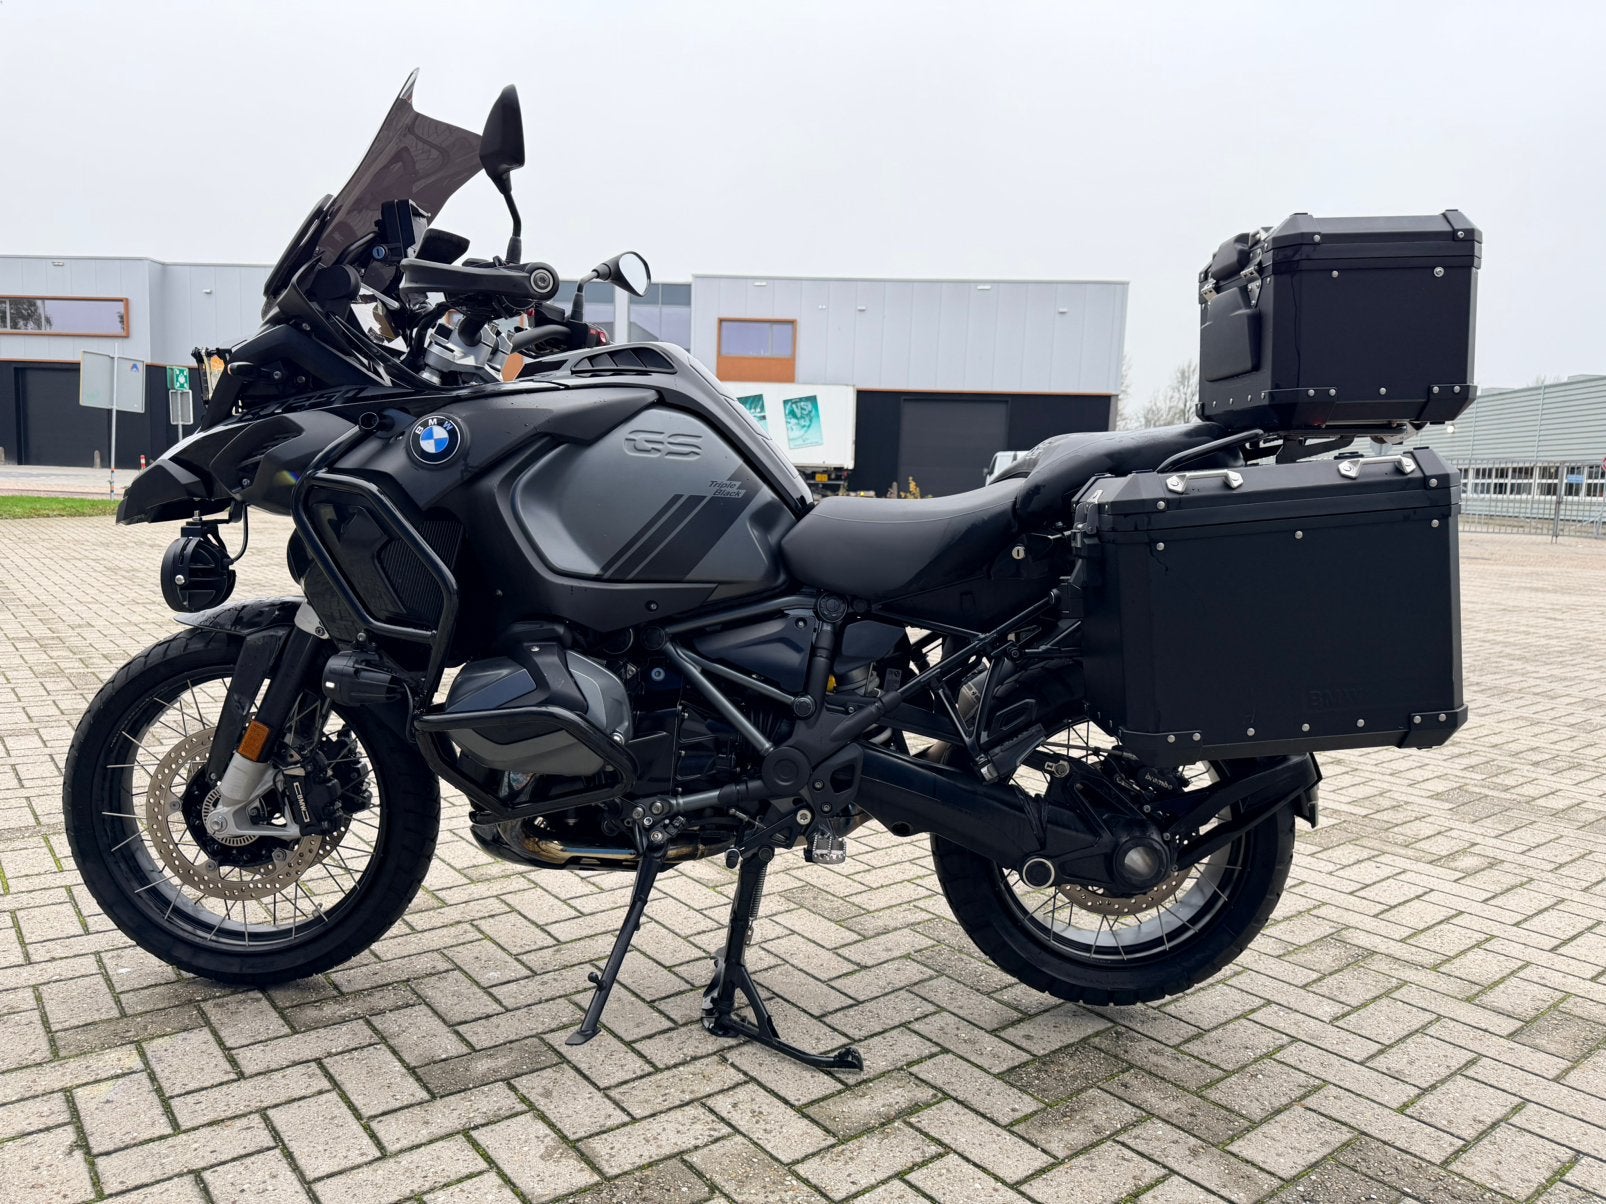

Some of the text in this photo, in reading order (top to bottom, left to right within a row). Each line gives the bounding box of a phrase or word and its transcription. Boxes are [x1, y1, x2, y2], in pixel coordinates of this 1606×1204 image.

[415, 418, 454, 435] BMW
[623, 430, 703, 460] GS
[708, 480, 737, 490] Triple
[712, 489, 742, 497] Black
[1145, 772, 1173, 790] brembo
